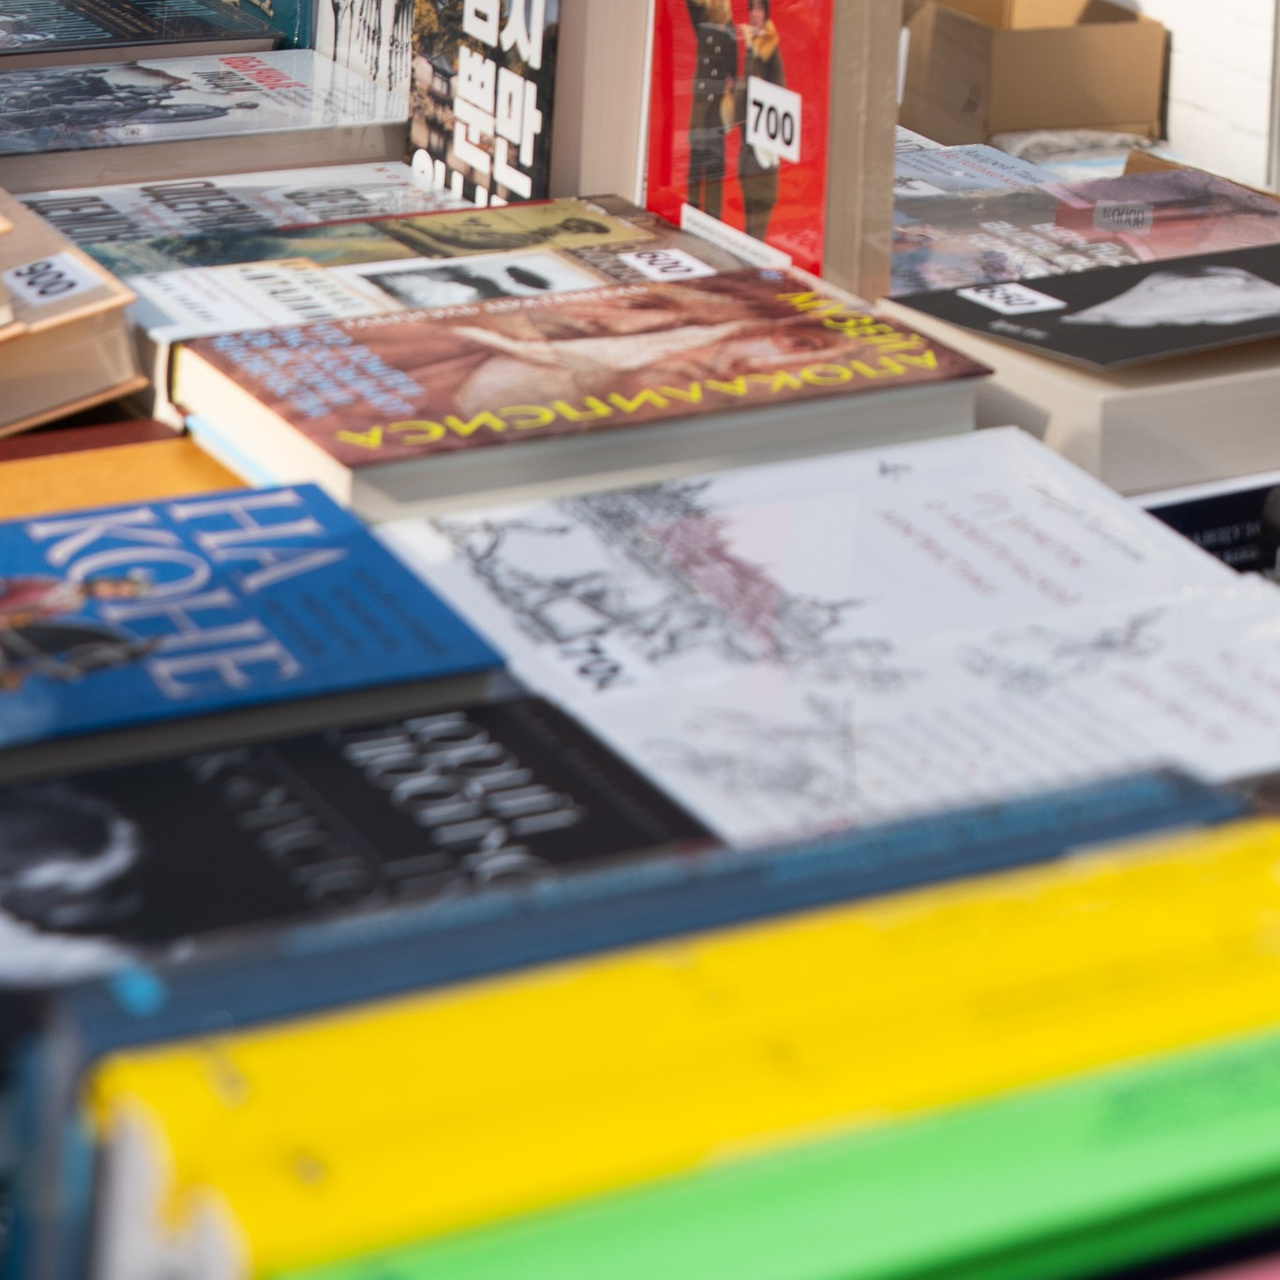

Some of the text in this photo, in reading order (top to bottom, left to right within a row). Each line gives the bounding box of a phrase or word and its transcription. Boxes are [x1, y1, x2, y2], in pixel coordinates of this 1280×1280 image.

[453, 44, 543, 200] 뿐만
[752, 99, 794, 146] 700
[15, 260, 76, 297] 900
[337, 349, 939, 450] АПОКАЛИПСИСА
